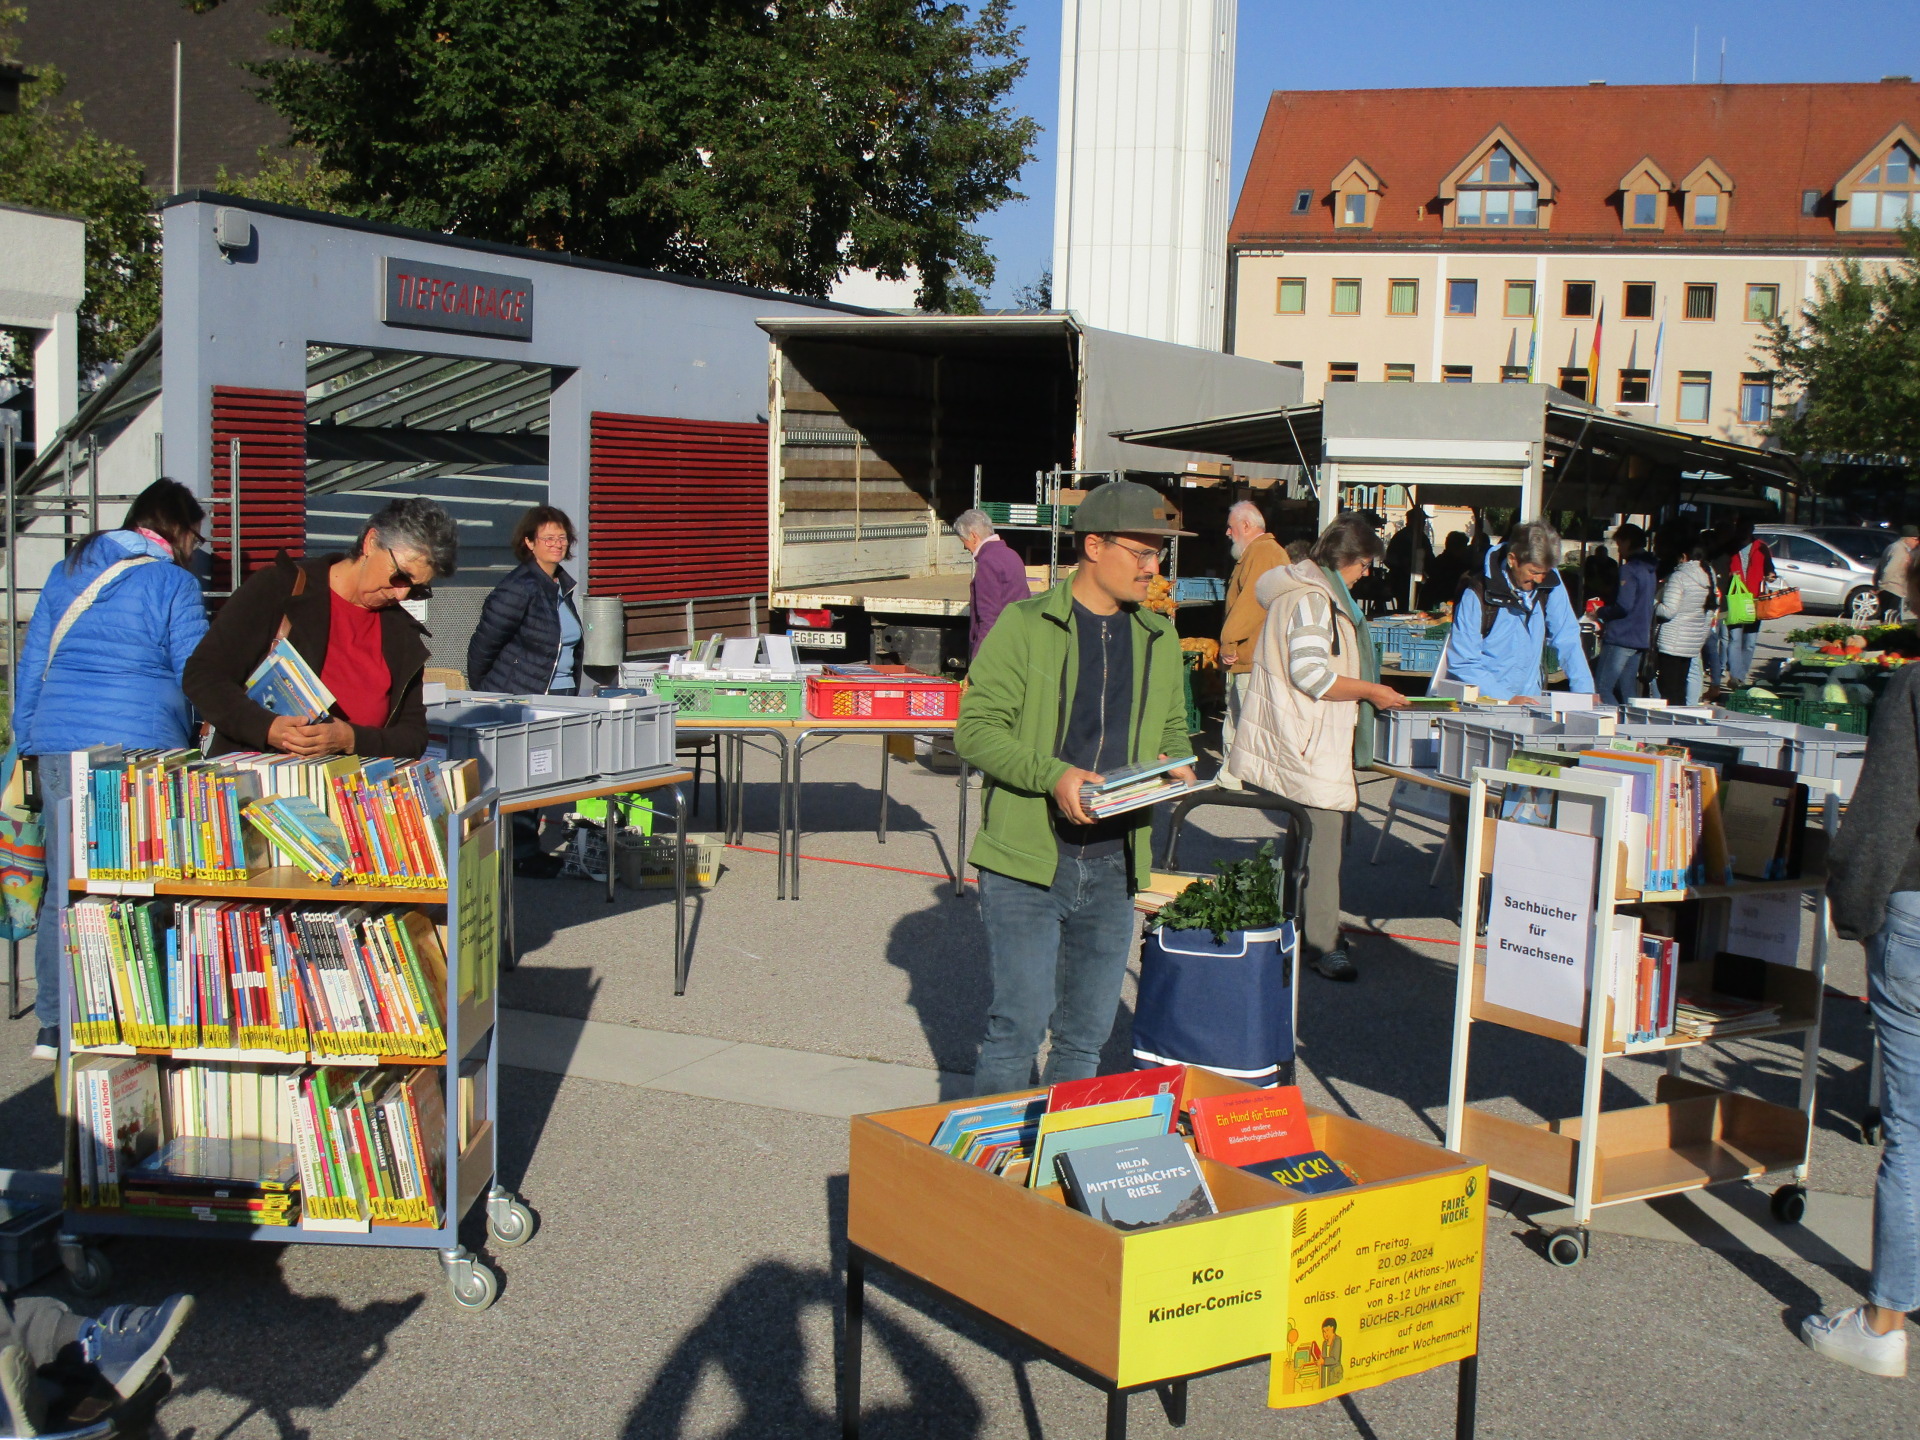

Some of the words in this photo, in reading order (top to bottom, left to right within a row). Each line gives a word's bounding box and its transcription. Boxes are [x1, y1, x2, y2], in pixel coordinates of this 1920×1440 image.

[397, 274, 526, 322] TIEFGARAGE
[793, 632, 806, 644] EG
[813, 633, 826, 644] FG
[830, 634, 843, 645] 15
[1504, 895, 1577, 922] Sachbücher
[139, 911, 151, 951] Wunderbare
[146, 953, 154, 968] Erde
[1528, 922, 1546, 938] für
[1499, 938, 1575, 967] Erwachsene
[402, 963, 419, 1004] FAHRZEUG
[100, 1079, 109, 1105] Kinder
[1216, 1114, 1230, 1126] Ein
[1230, 1110, 1250, 1123] Hund
[1252, 1110, 1263, 1121] für
[1263, 1107, 1289, 1118] Emma
[1240, 1125, 1251, 1133] und
[1252, 1123, 1272, 1132] andere
[104, 1115, 116, 1172] Musiklexikon
[1116, 1158, 1150, 1170] HILDA
[1272, 1157, 1334, 1186] RUCK!
[1086, 1166, 1192, 1194] MITTERNACHTS-
[1126, 1183, 1162, 1199] RIESE
[1440, 1207, 1469, 1226] WOCHE
[1441, 1195, 1466, 1213] FAIRE
[1291, 1199, 1355, 1259] meindebibliothek
[1297, 1227, 1341, 1269] Burgkirchen
[1356, 1245, 1370, 1257] am
[1374, 1237, 1413, 1253] Freitag,
[1378, 1247, 1434, 1270] 20.09.2024
[1295, 1239, 1342, 1284] veranstaltet
[1192, 1267, 1224, 1285] KCo
[1148, 1289, 1263, 1324] Kinder-Comics
[1304, 1289, 1339, 1305] anläss.
[1344, 1282, 1361, 1296] der
[1367, 1298, 1383, 1309] von
[1387, 1290, 1411, 1305] 8-12
[1414, 1284, 1431, 1297] Uhr
[1433, 1278, 1457, 1292] einen
[1398, 1326, 1413, 1338] auf
[1416, 1318, 1434, 1333] dem
[1349, 1343, 1410, 1369] Burgkirchner
[1413, 1322, 1473, 1351] Wochenmarkt!
